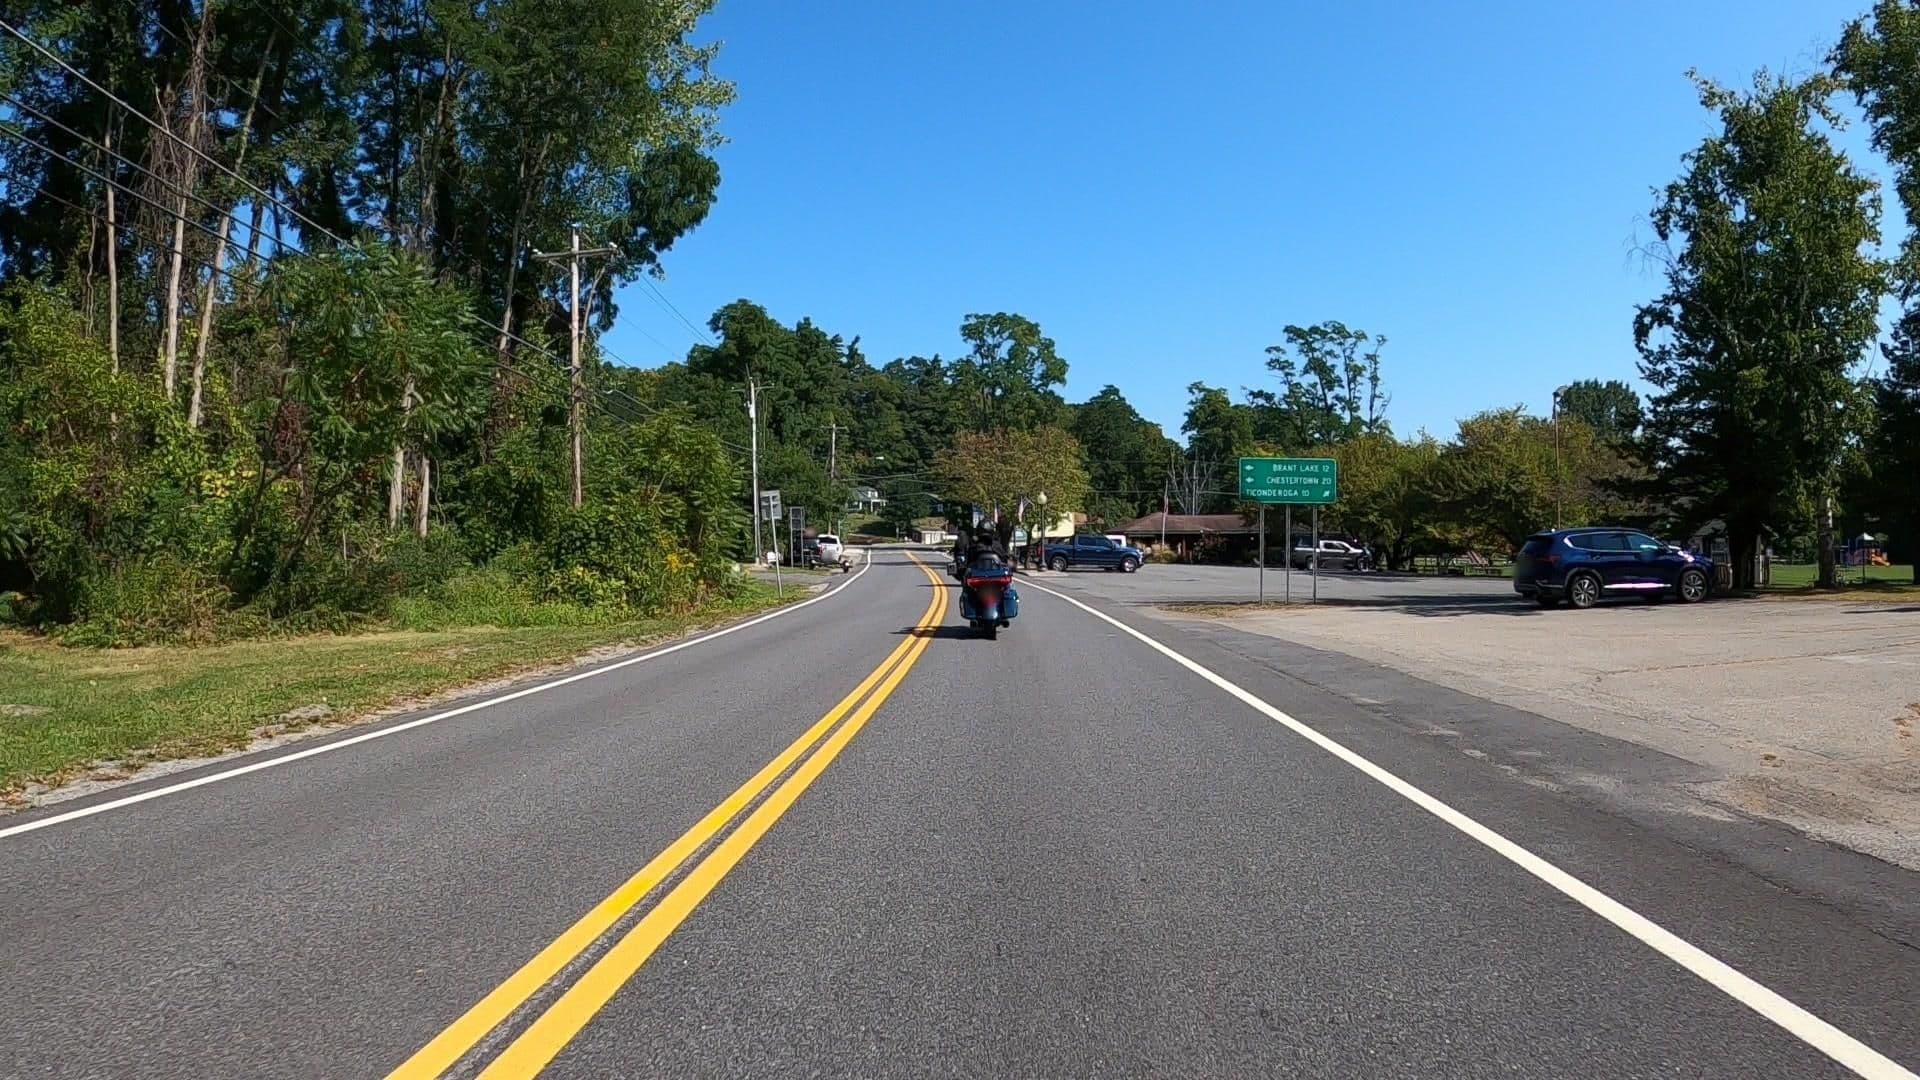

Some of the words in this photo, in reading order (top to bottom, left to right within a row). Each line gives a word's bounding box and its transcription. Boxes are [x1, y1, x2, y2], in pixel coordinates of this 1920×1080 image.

[1272, 464, 1297, 472] BRANT
[1300, 464, 1319, 472] LAKE
[1322, 465, 1330, 473] 12
[1266, 476, 1319, 485] CHESTERTOWN
[1321, 477, 1332, 485] 20
[1246, 489, 1298, 497] TICONDEROGA
[1301, 489, 1310, 497] 10
